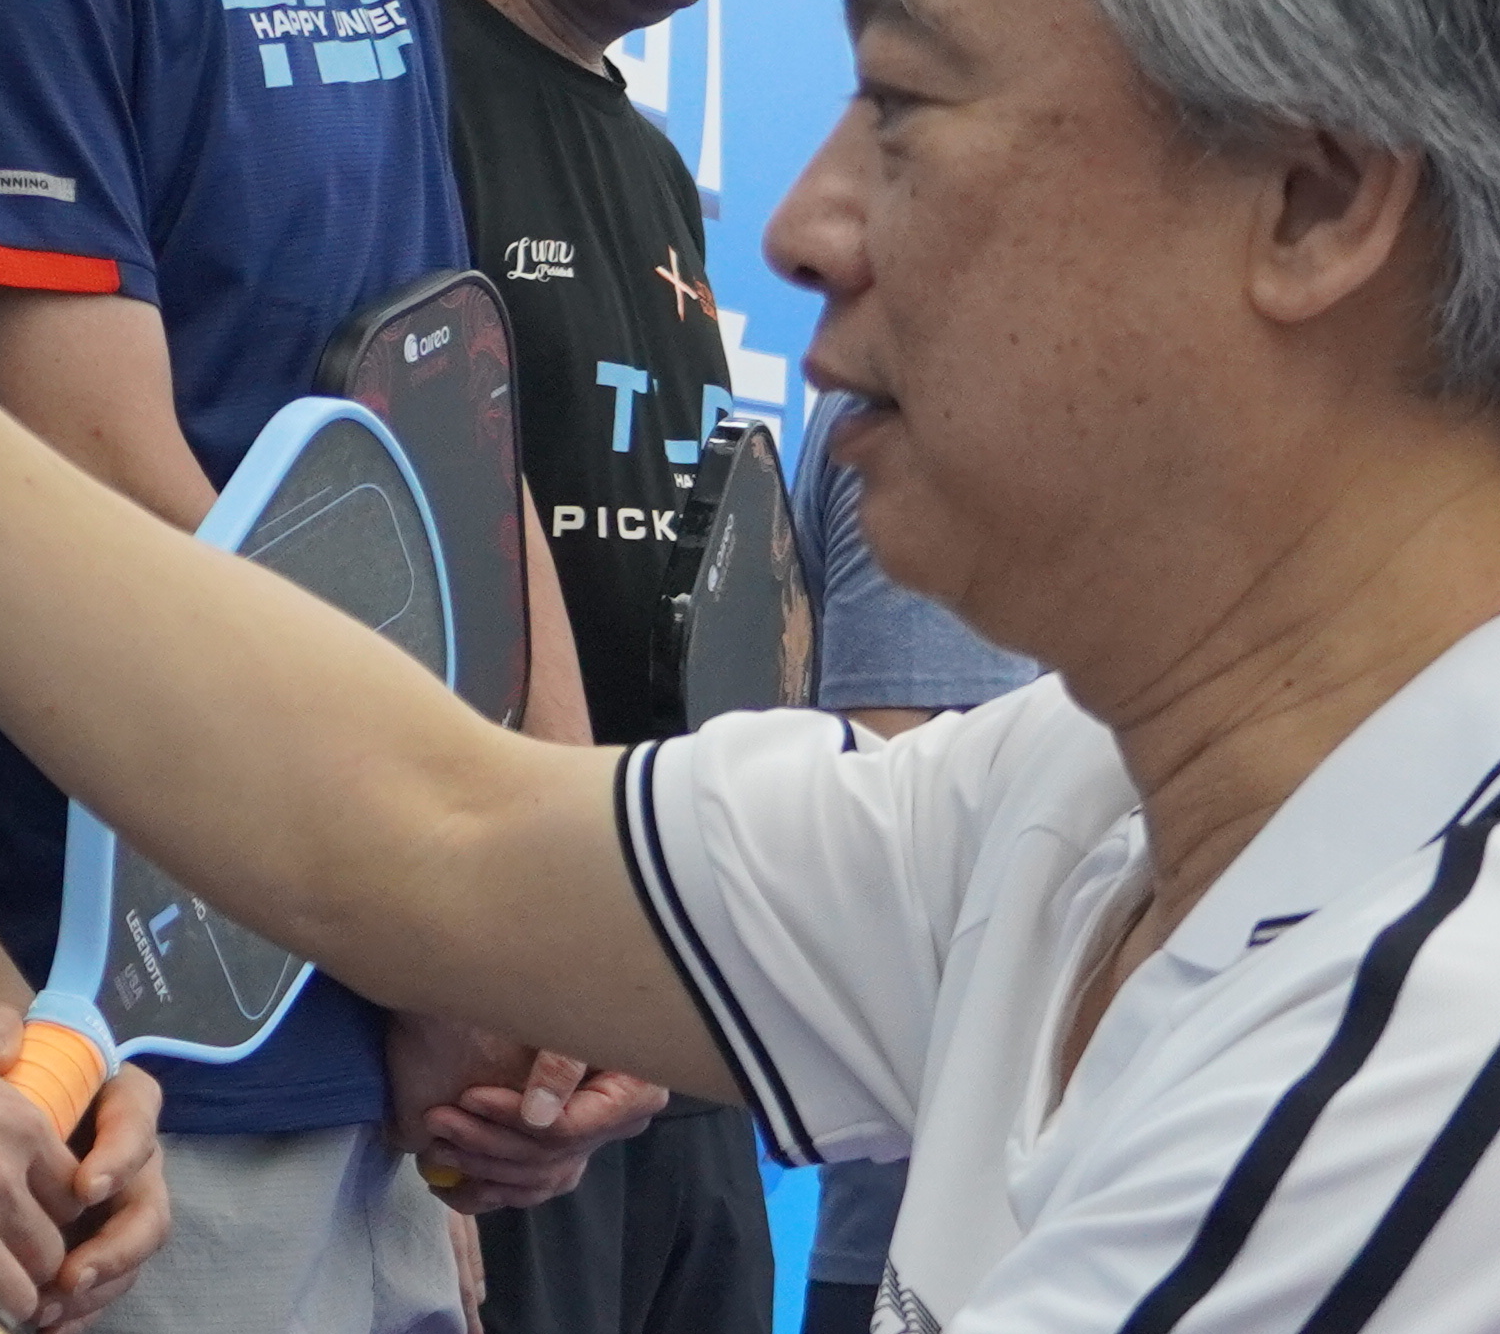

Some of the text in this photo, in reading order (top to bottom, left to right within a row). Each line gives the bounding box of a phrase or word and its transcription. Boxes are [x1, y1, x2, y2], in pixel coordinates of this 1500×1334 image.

[250, 9, 328, 40] HAPPY
[673, 472, 697, 489] HA
[552, 505, 683, 542] PICK
[125, 907, 169, 1004] LEGENDTEK
